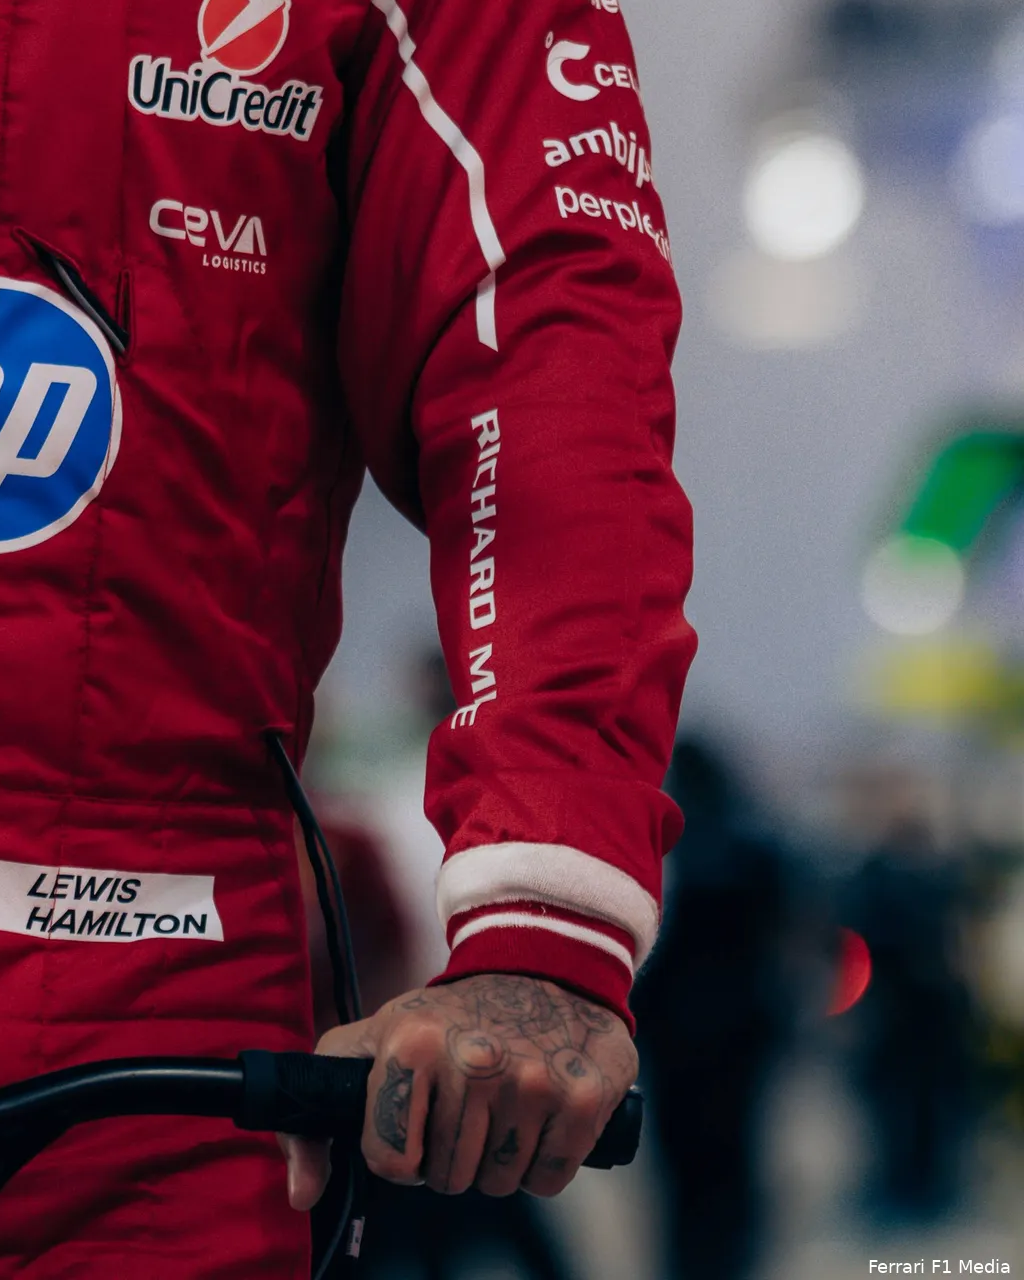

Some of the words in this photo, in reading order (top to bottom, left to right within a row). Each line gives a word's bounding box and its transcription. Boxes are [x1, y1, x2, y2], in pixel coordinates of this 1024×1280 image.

[132, 61, 316, 136] UniCredit
[202, 254, 267, 275] LOGISTICS
[469, 408, 501, 631] RICHARD
[27, 873, 141, 903] LEWIS
[25, 906, 207, 936] HAMILTON
